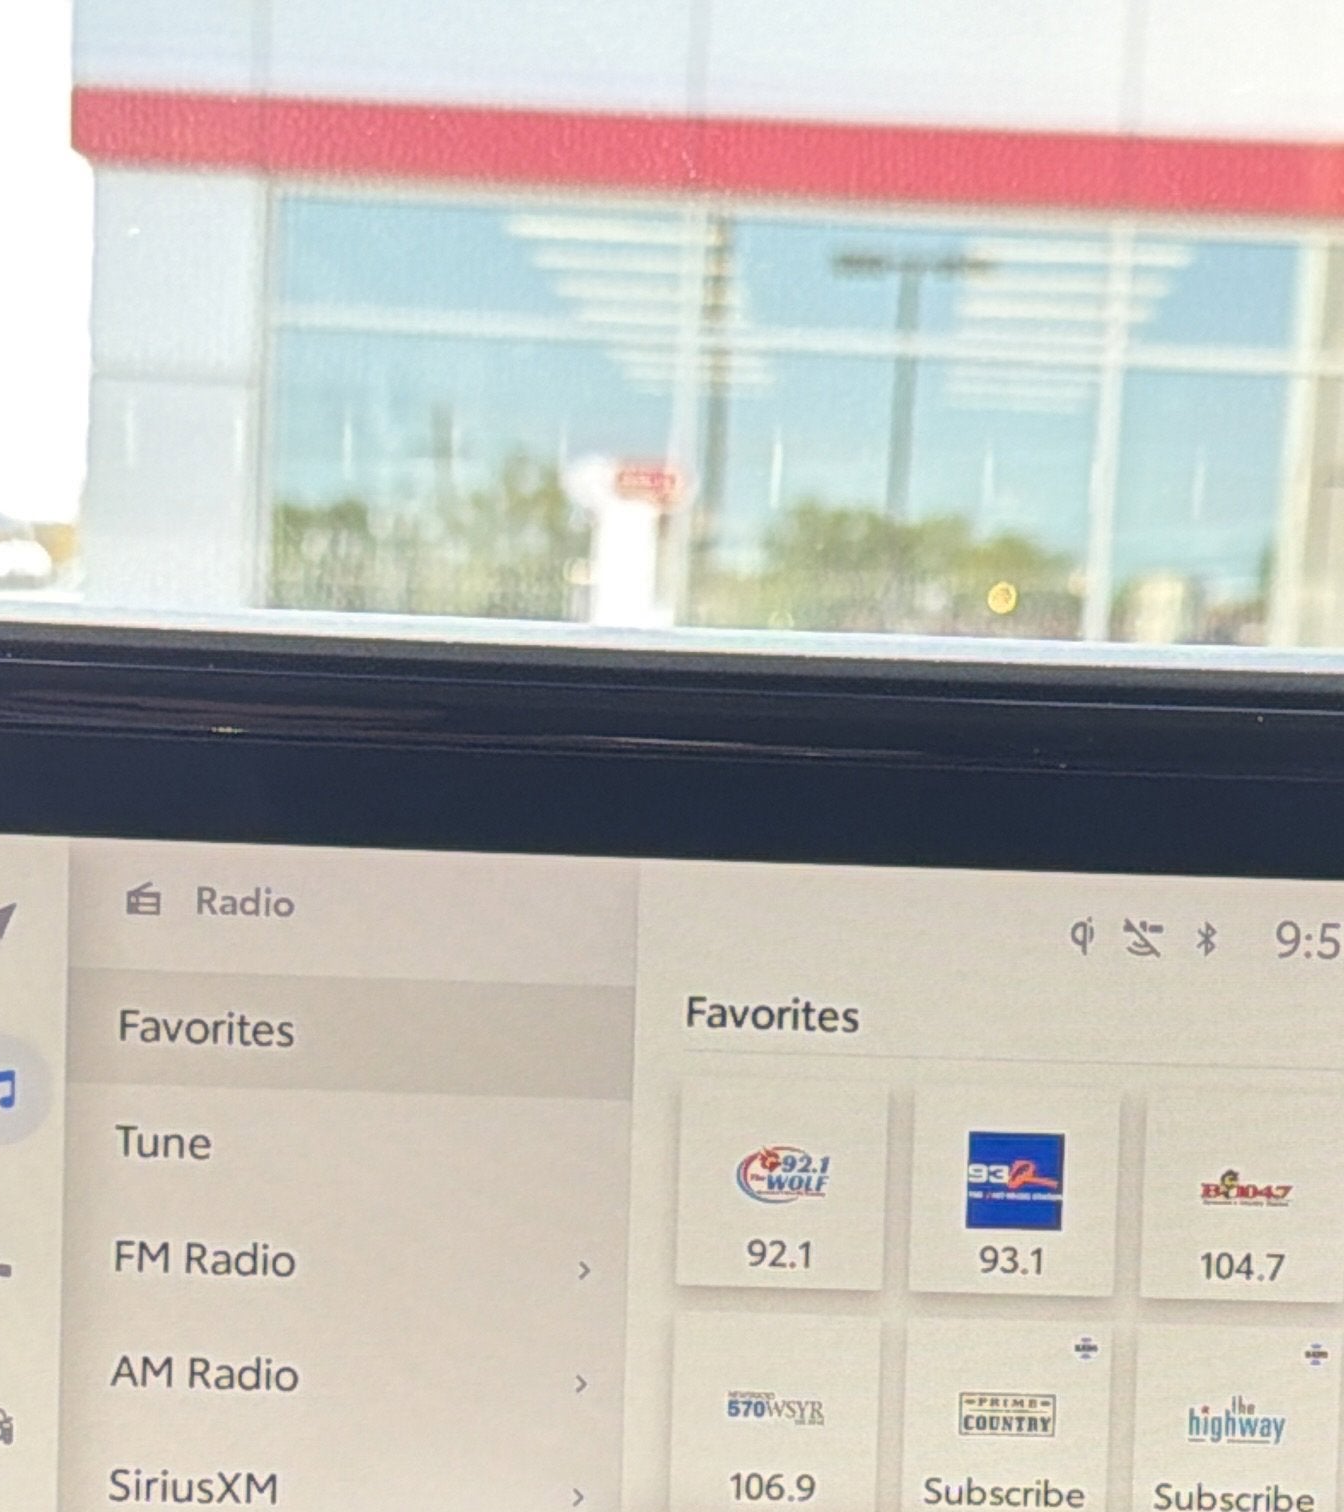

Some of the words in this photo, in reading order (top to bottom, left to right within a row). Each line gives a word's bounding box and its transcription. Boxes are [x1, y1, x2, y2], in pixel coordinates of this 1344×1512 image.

[196, 886, 295, 918] Radio
[120, 1009, 294, 1048] Favorites
[687, 996, 859, 1033] Favorites
[115, 1124, 212, 1160] Tune
[780, 1154, 830, 1174] 92.1
[767, 1173, 829, 1192] WOLF
[115, 1240, 170, 1273] FM
[185, 1242, 296, 1278] Radio
[747, 1238, 811, 1269] 92.1
[979, 1245, 1043, 1275] 93.1
[1201, 1252, 1285, 1281] 104.7
[110, 1355, 173, 1388] AM
[188, 1356, 299, 1392] Radio
[977, 1398, 1037, 1408] PRIME
[1232, 1395, 1255, 1415] the
[963, 1415, 1051, 1432] COUNTRY
[1189, 1406, 1286, 1444] highway
[109, 1468, 277, 1505] SiriusXM
[730, 1472, 816, 1502] 106.9
[924, 1477, 1085, 1509] Subscribe
